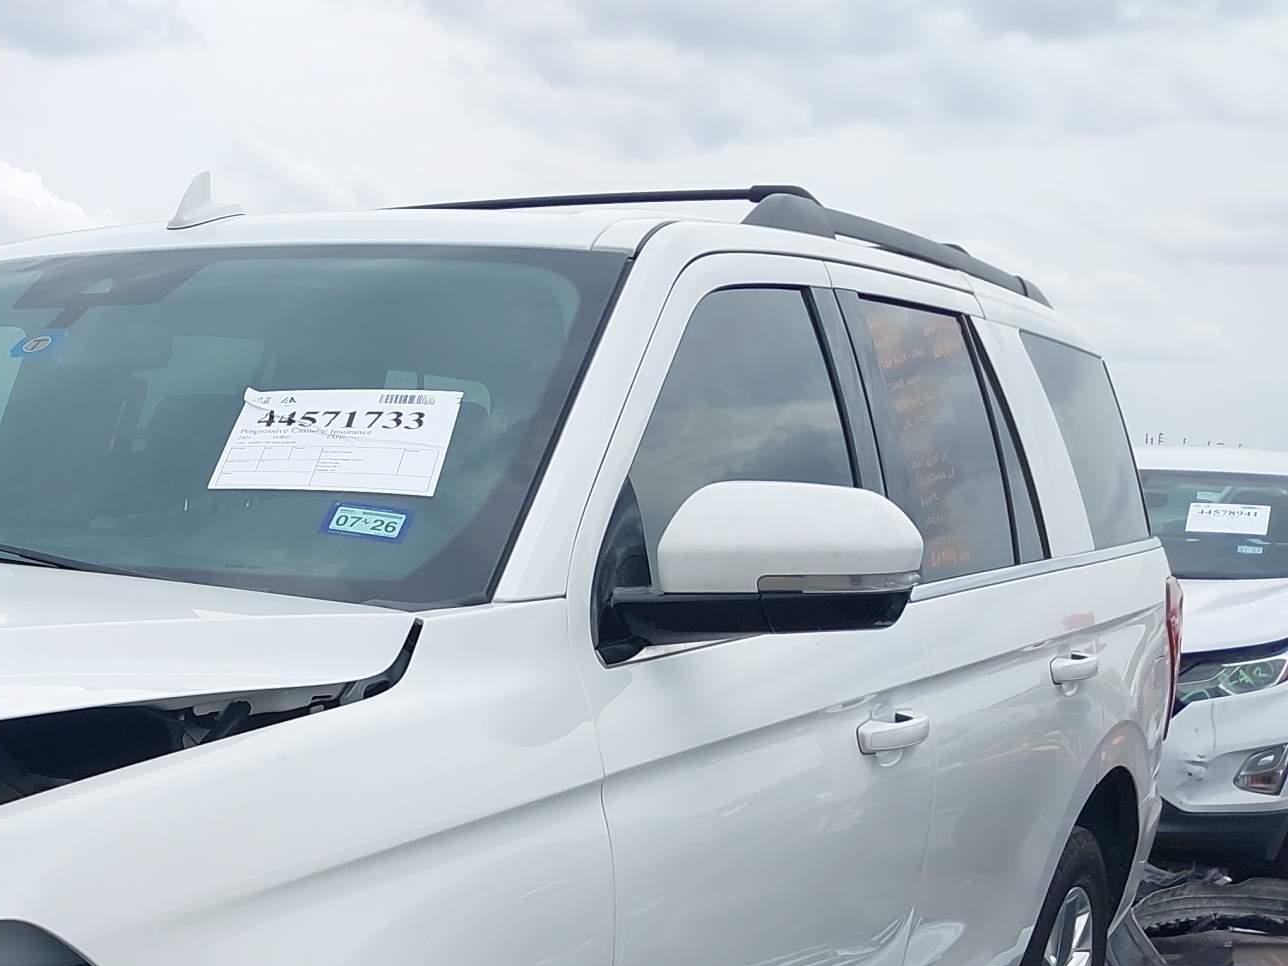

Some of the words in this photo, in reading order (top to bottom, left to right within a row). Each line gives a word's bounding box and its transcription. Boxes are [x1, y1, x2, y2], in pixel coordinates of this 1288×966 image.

[257, 409, 426, 430] 44571733
[335, 514, 363, 528] 07
[370, 519, 398, 533] 26
